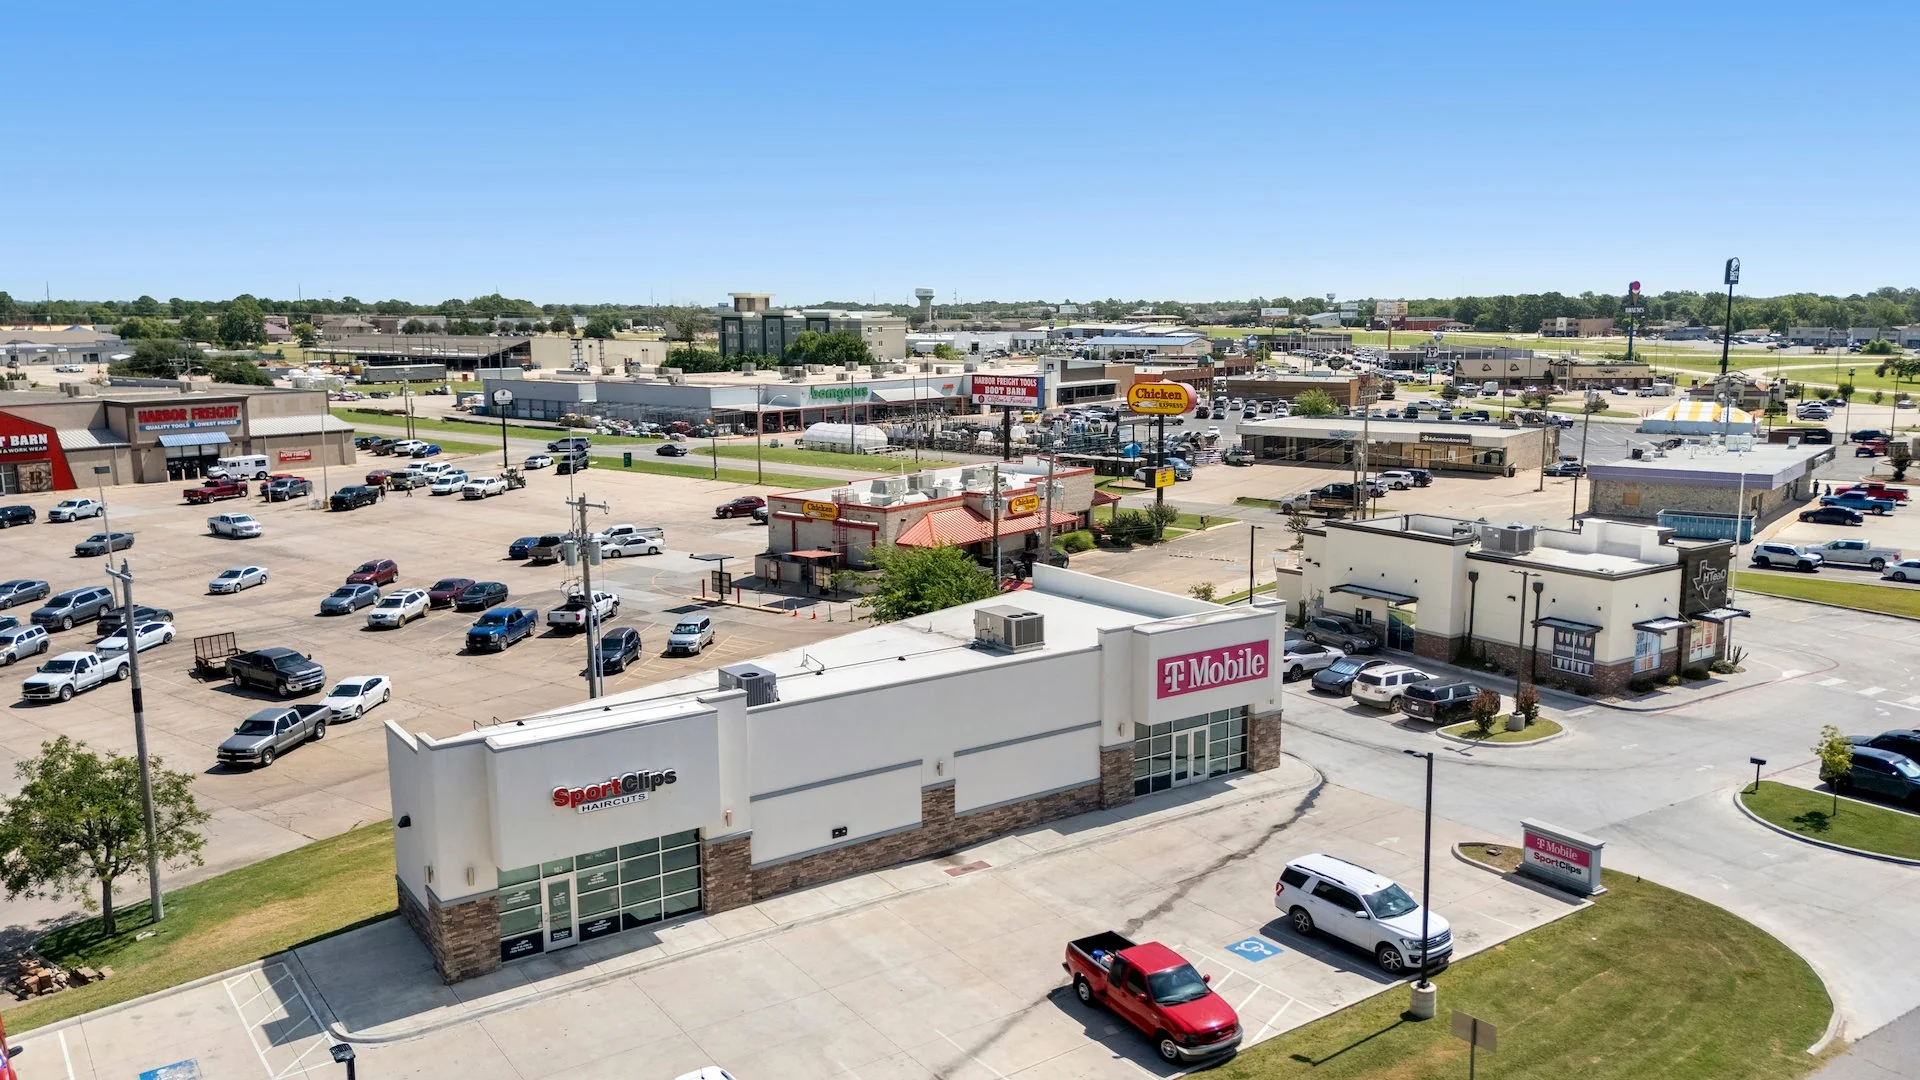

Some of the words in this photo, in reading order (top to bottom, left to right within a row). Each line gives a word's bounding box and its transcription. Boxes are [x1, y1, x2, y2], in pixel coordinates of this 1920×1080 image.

[974, 376, 996, 385] HARBOR
[997, 378, 1018, 386] FREIGHT
[1021, 379, 1037, 387] TOOLS
[985, 386, 1004, 394] BOOT
[1006, 387, 1027, 396] BARN
[1135, 388, 1182, 400] Chicken
[138, 409, 187, 423] HARBOR
[191, 406, 239, 420] FREIGHT
[10, 434, 48, 446] BARN
[1164, 661, 1184, 692] T
[1188, 648, 1265, 689] Mobile
[553, 769, 677, 808] SportClips
[582, 794, 645, 812] HAIRCUTS
[1546, 842, 1578, 861] Mobile
[1534, 851, 1582, 875] SportClips
